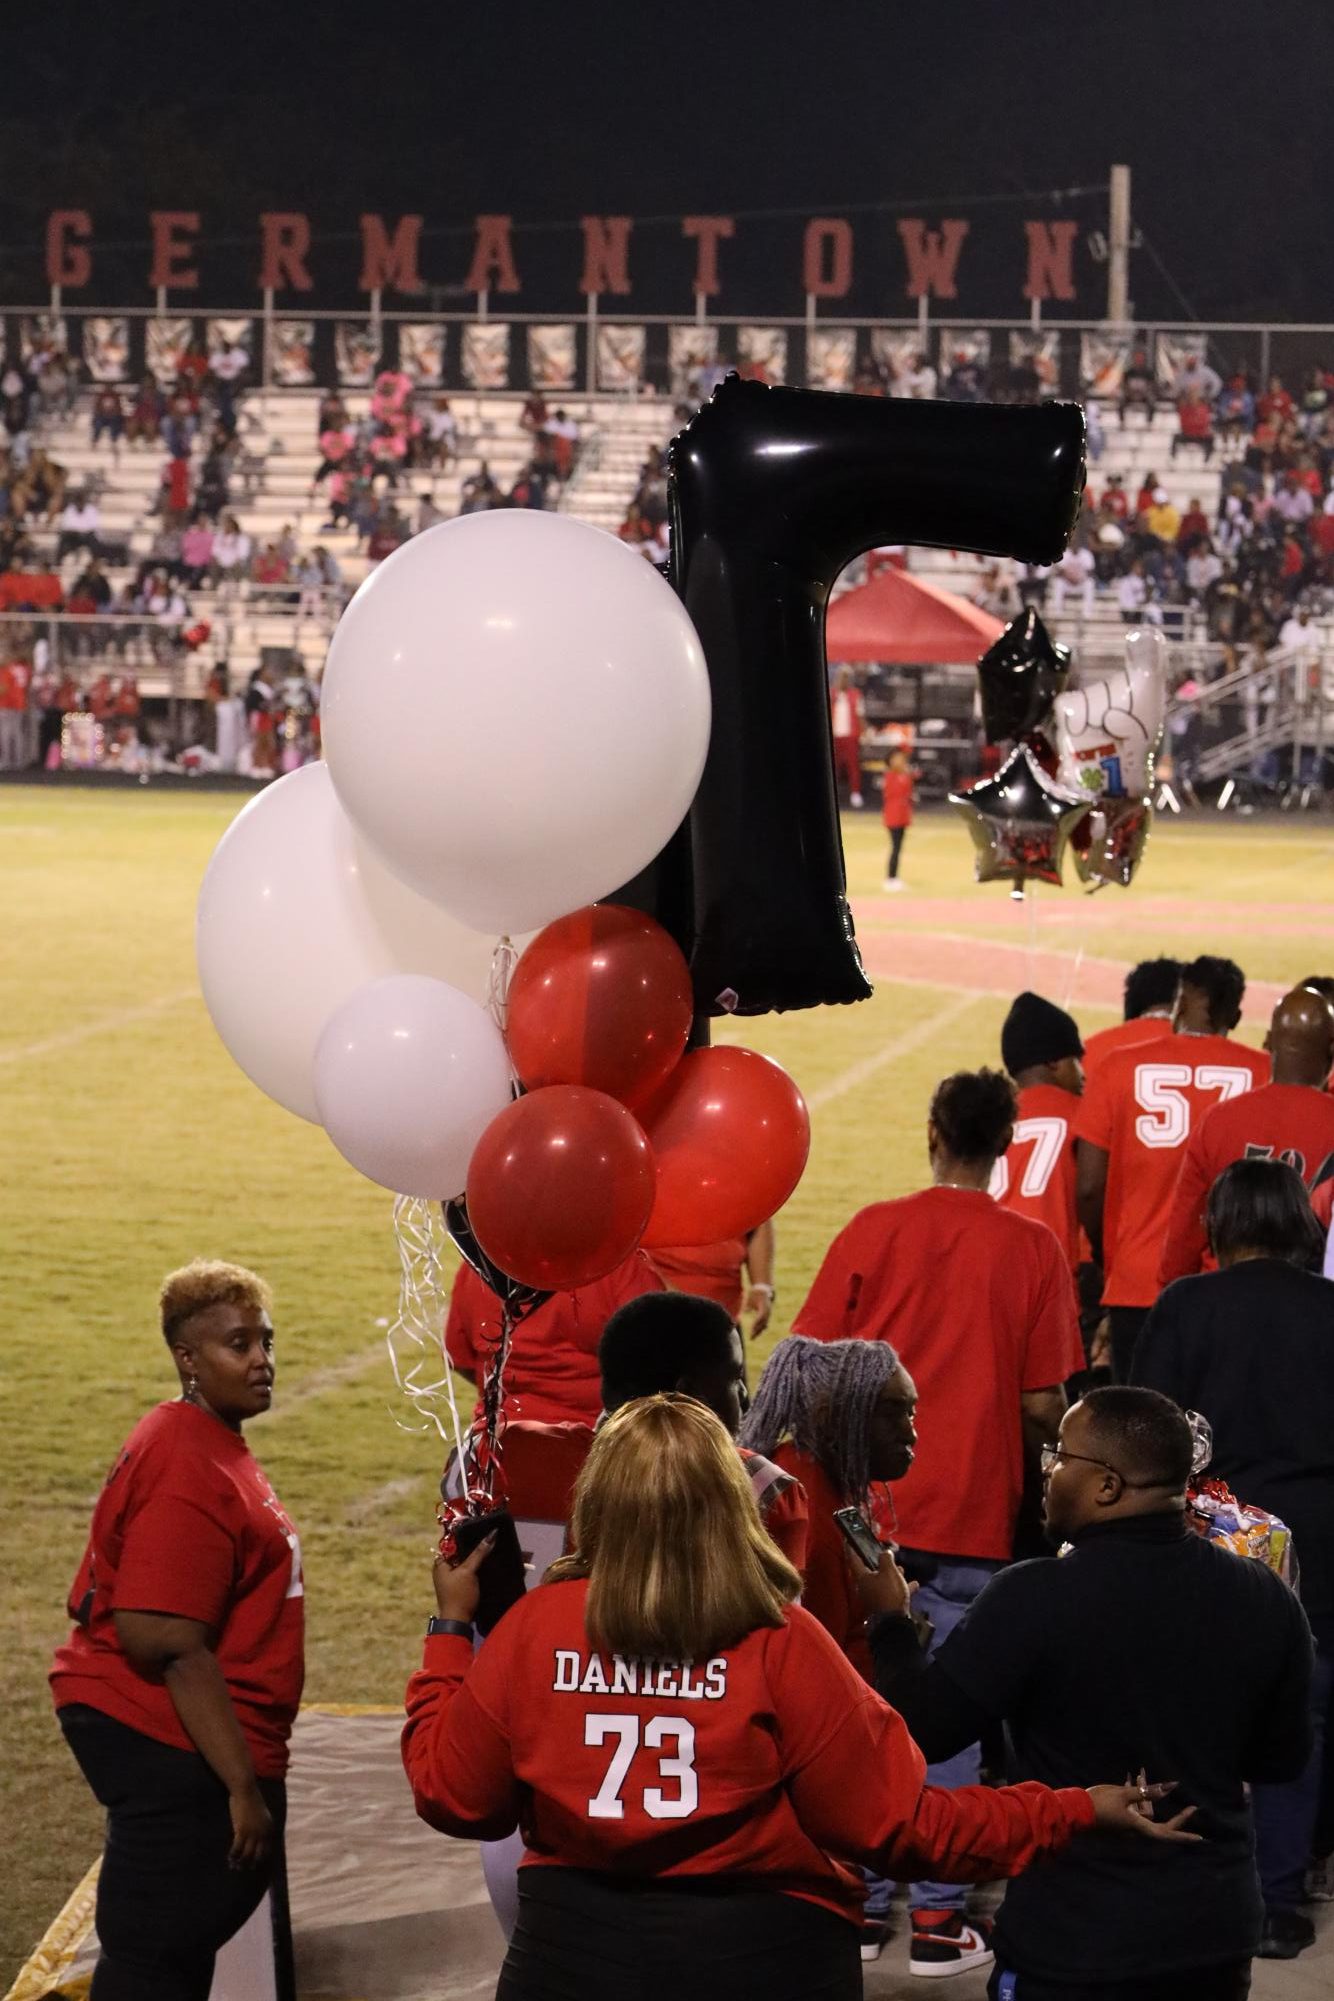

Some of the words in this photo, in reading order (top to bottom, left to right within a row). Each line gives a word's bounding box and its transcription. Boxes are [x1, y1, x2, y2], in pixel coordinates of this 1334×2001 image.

[47, 210, 1077, 300] GERMANTOWN
[554, 1650, 727, 1699] DANIELS
[585, 1714, 697, 1818] 73
